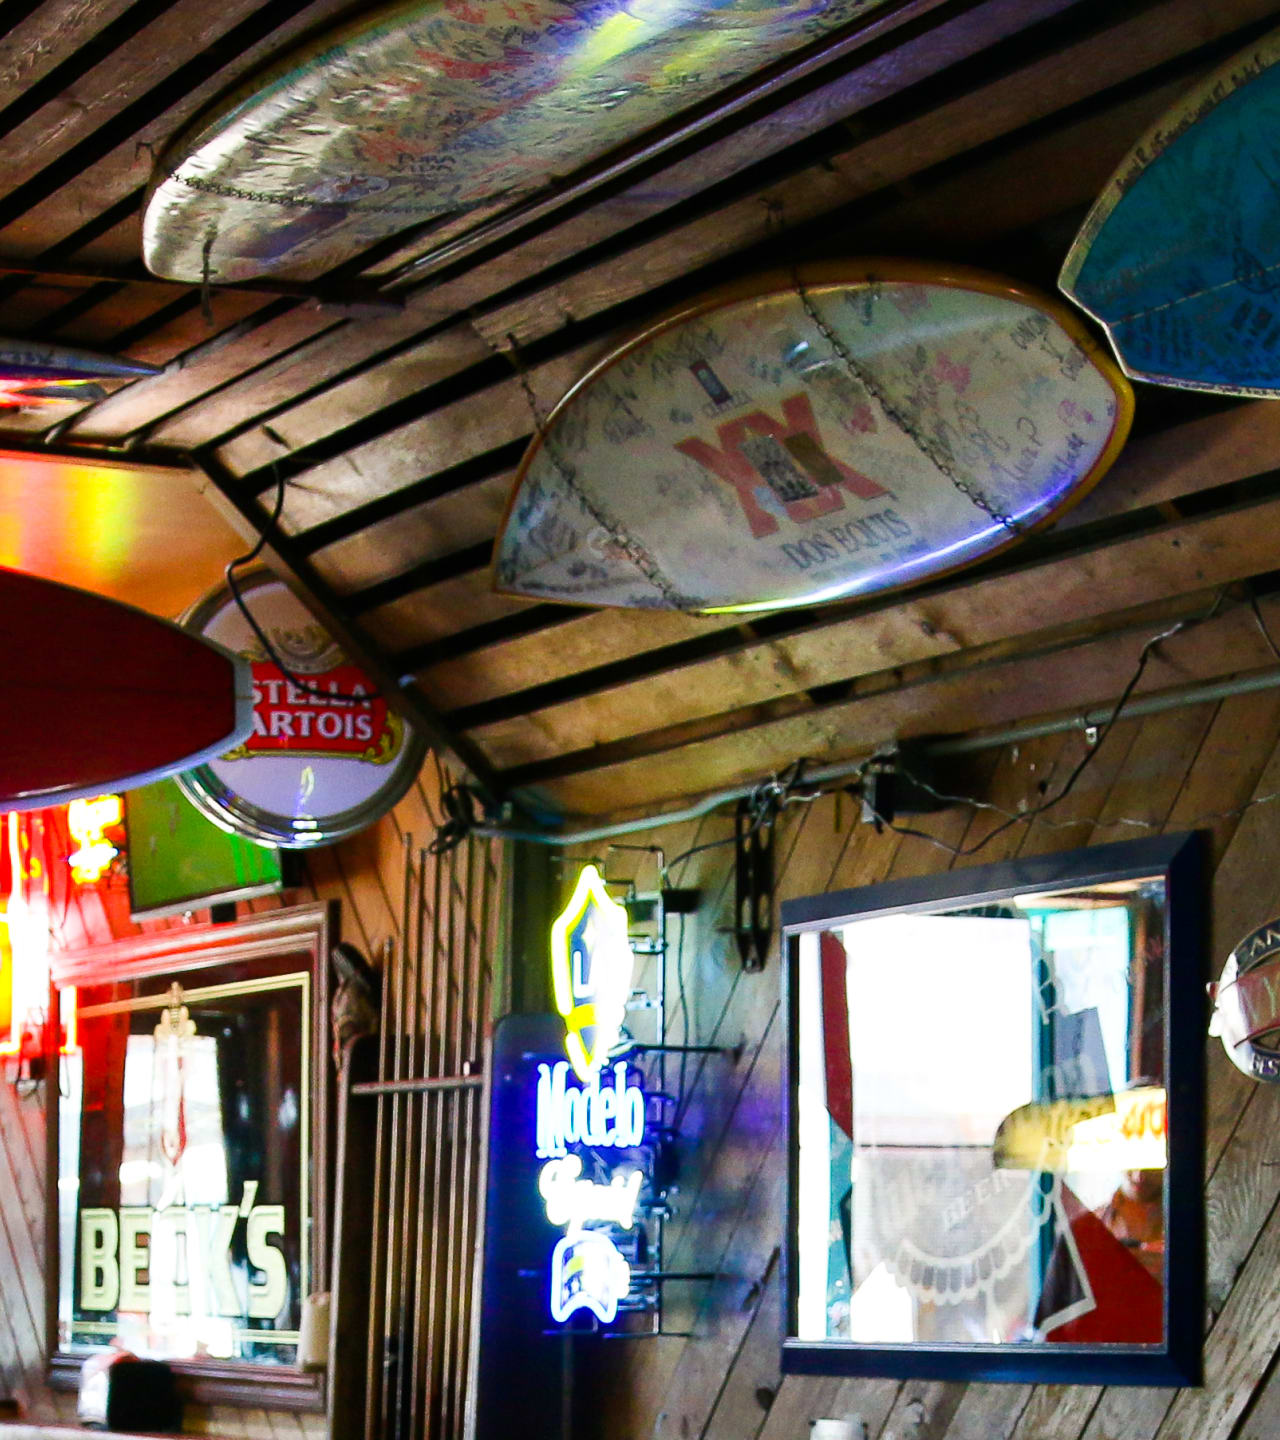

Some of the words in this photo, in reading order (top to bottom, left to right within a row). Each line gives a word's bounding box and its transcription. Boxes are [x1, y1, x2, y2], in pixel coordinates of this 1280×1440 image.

[779, 533, 841, 570] DOS
[826, 508, 913, 555] EQUIS
[251, 710, 374, 741] ARTOIS
[535, 1061, 646, 1160] Modelo
